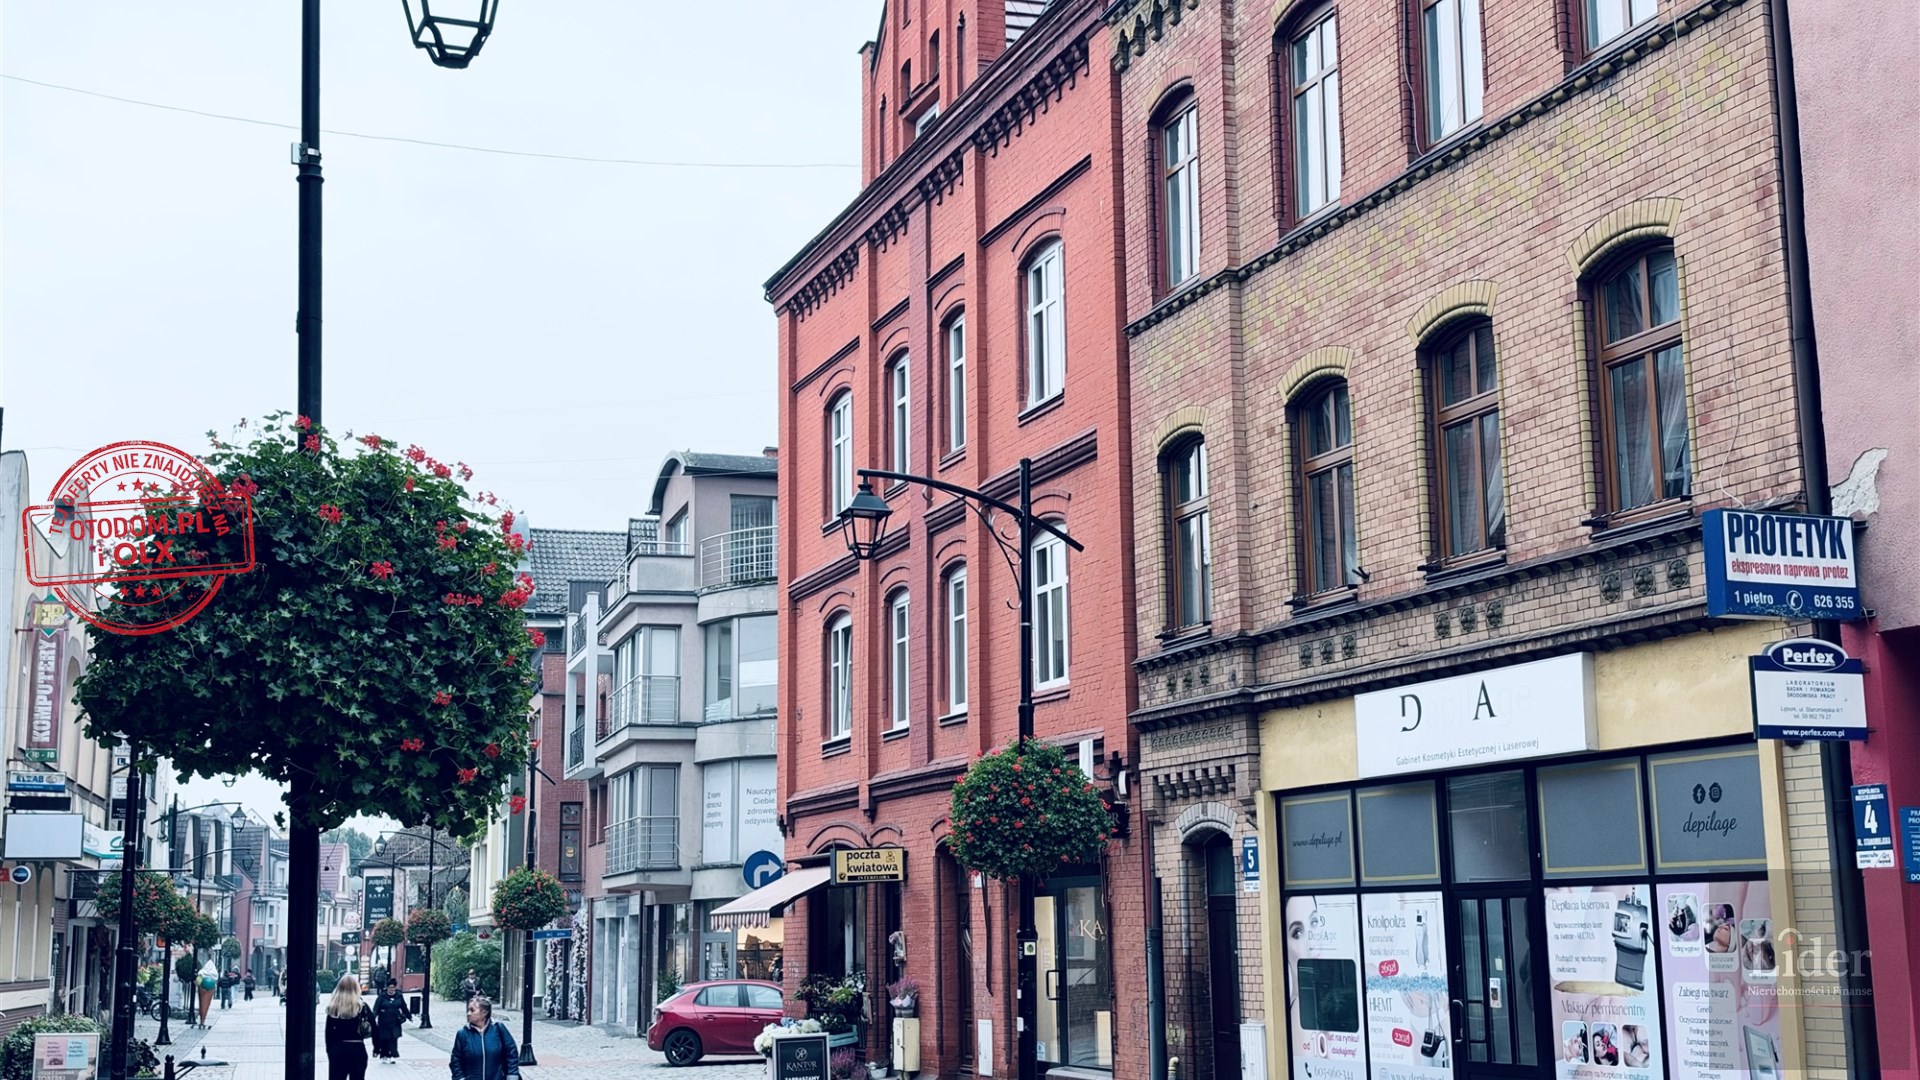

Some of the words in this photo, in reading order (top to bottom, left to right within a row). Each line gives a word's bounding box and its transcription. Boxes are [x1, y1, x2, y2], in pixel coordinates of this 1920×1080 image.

[1727, 513, 1847, 559] PROTETYK
[1732, 559, 1781, 576] ekspresowa
[1784, 564, 1820, 578] naprawa
[1822, 566, 1849, 580] protez
[1734, 590, 1740, 603] 1
[1744, 591, 1774, 606] piętro
[1814, 595, 1833, 608] 626
[1835, 596, 1854, 609] 355
[1783, 648, 1835, 664] Perfex
[32, 639, 56, 742] KOMPUTERY
[1782, 729, 1845, 738] www.perfex.com.pl
[1396, 754, 1421, 766] Gabinet
[1422, 750, 1456, 763] Kosmetyki
[1458, 745, 1497, 758] Estetycznej
[1503, 737, 1539, 752] Laserowej
[1683, 810, 1737, 838] depilage
[1863, 804, 1879, 834] 4
[846, 850, 881, 862] poczta
[1247, 849, 1255, 870] 5
[846, 862, 899, 873] kwiatowa
[1710, 989, 1729, 999] twarz
[1591, 1003, 1646, 1018] permanentny
[786, 1060, 817, 1071] KANTOR
